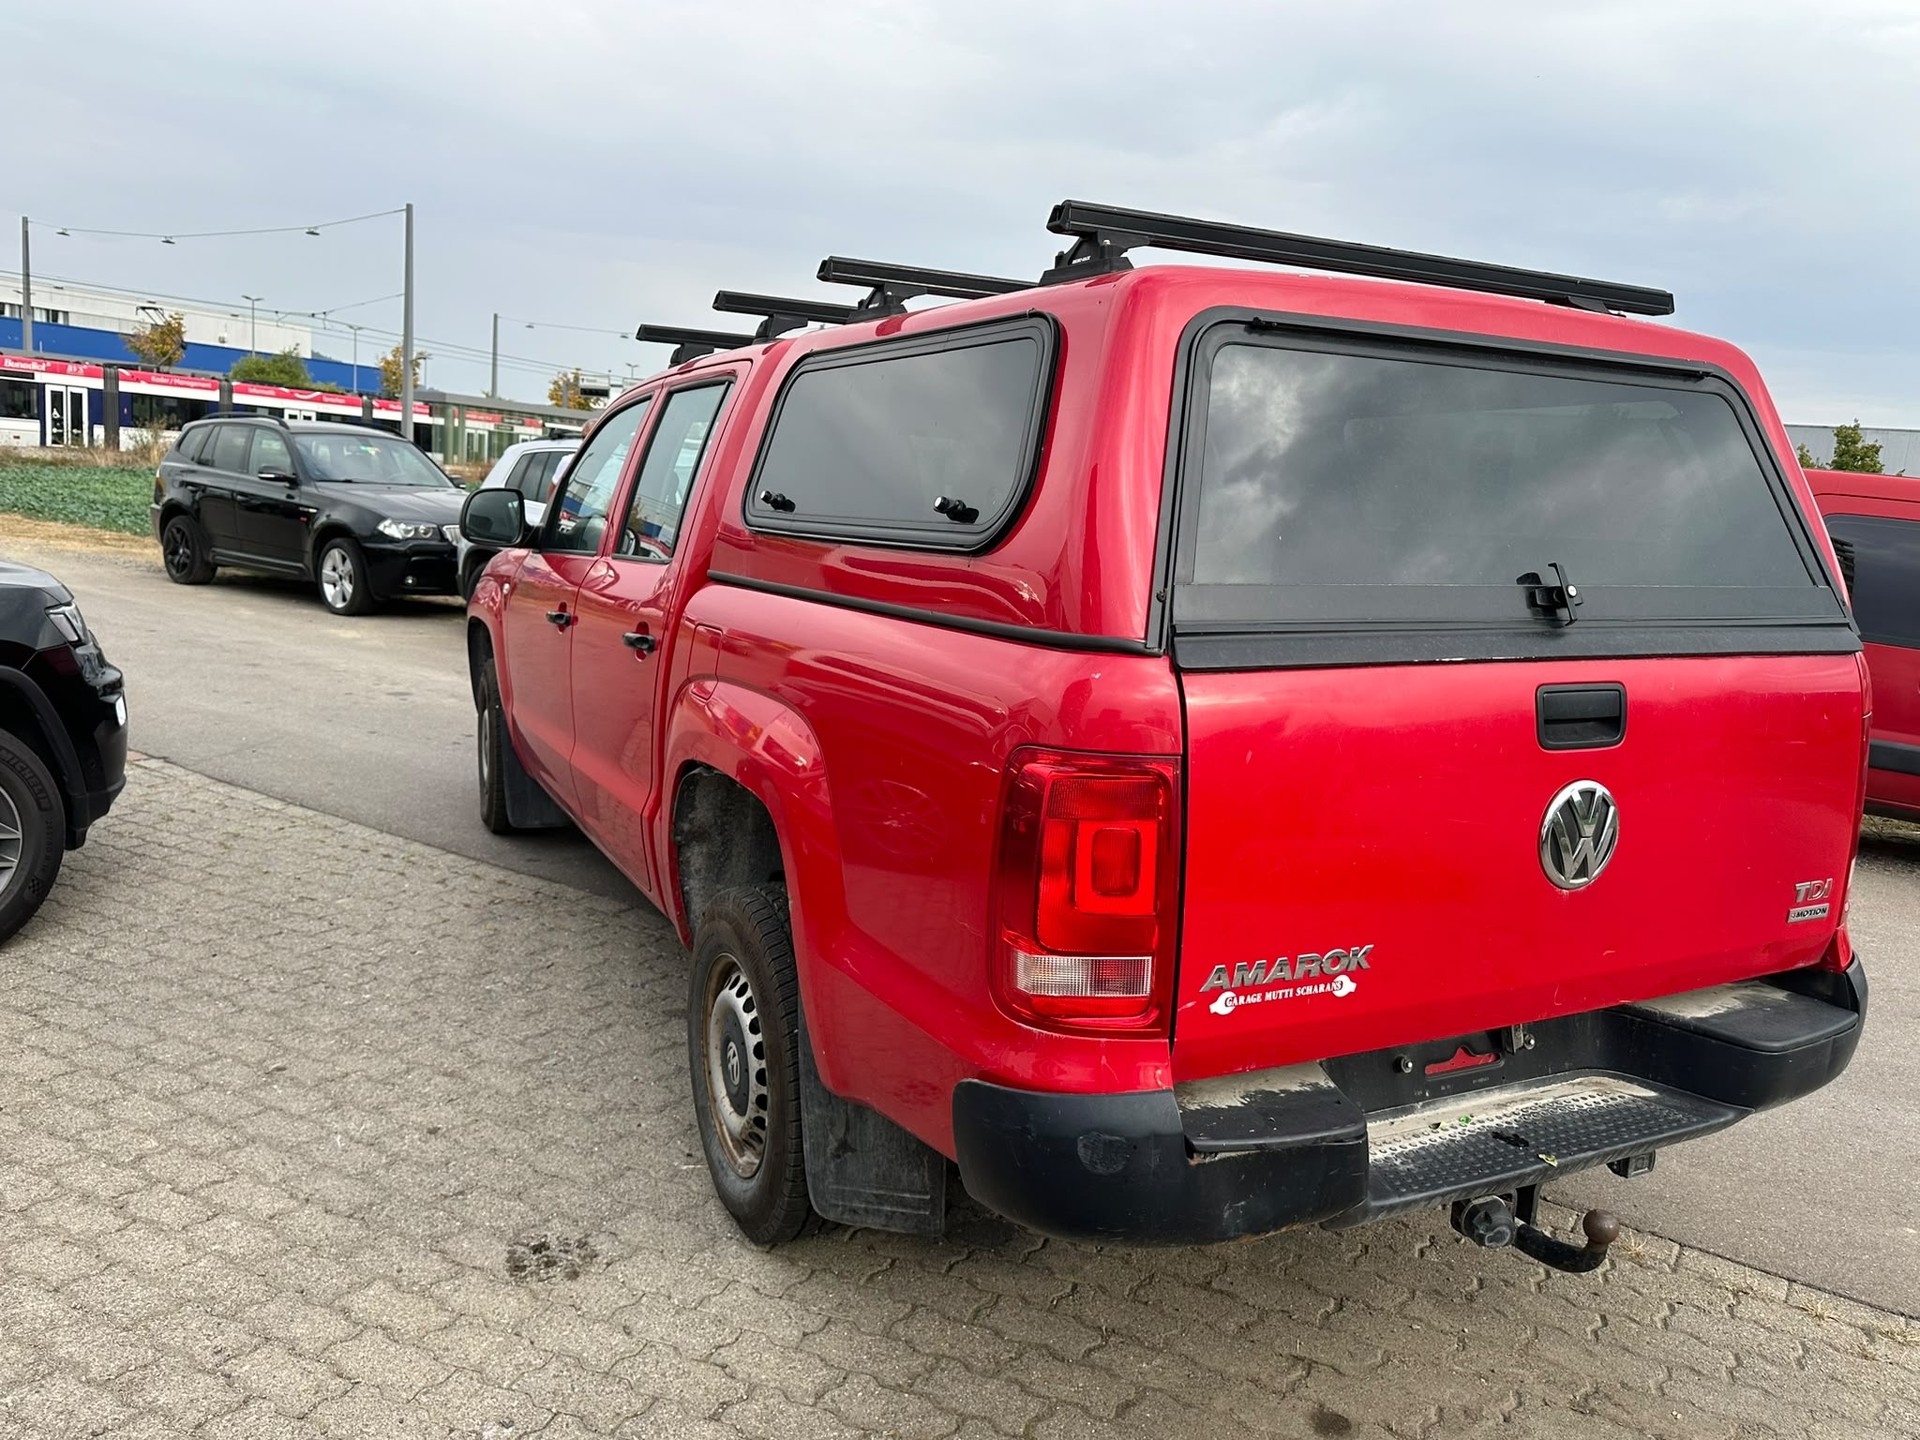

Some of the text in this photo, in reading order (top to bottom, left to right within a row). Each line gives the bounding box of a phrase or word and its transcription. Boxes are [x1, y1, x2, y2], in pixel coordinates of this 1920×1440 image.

[1541, 780, 1618, 888] VW
[1795, 878, 1833, 903] TDI
[1199, 944, 1374, 992] AMAROK
[1225, 980, 1343, 1008] GARAGE MUTTI SCHARANS
